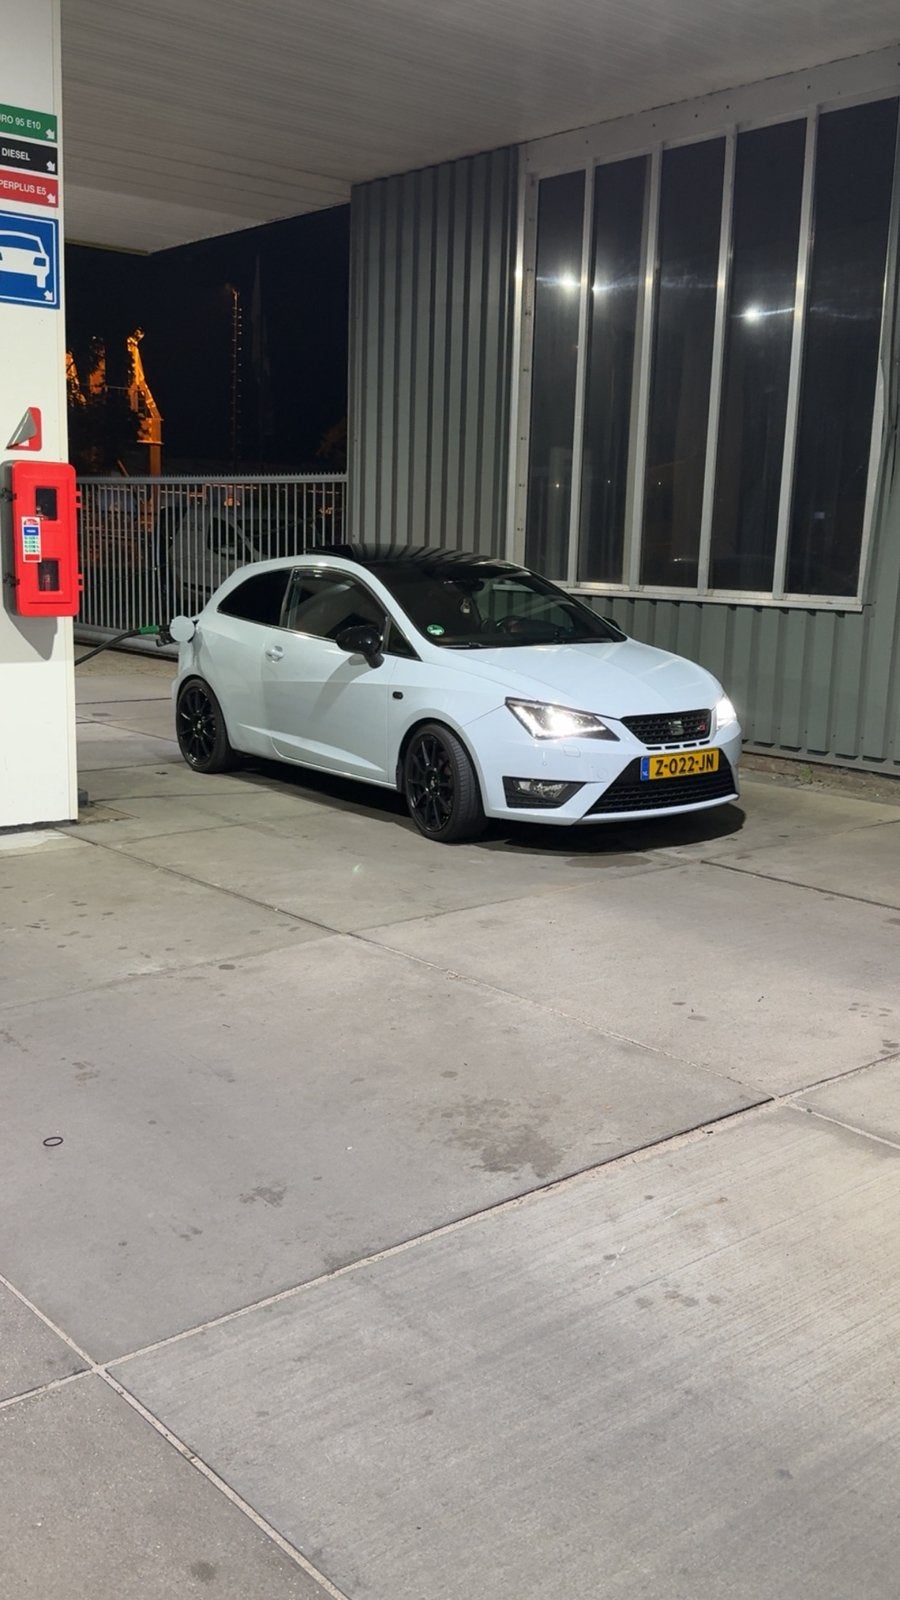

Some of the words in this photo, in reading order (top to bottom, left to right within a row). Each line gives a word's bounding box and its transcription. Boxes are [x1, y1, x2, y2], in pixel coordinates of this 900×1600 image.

[0, 114, 13, 124] RO
[15, 117, 24, 126] 95
[27, 120, 41, 129] E10
[2, 148, 30, 160] DIESEL
[36, 186, 47, 195] E5
[655, 753, 714, 776] Z-022-JN
